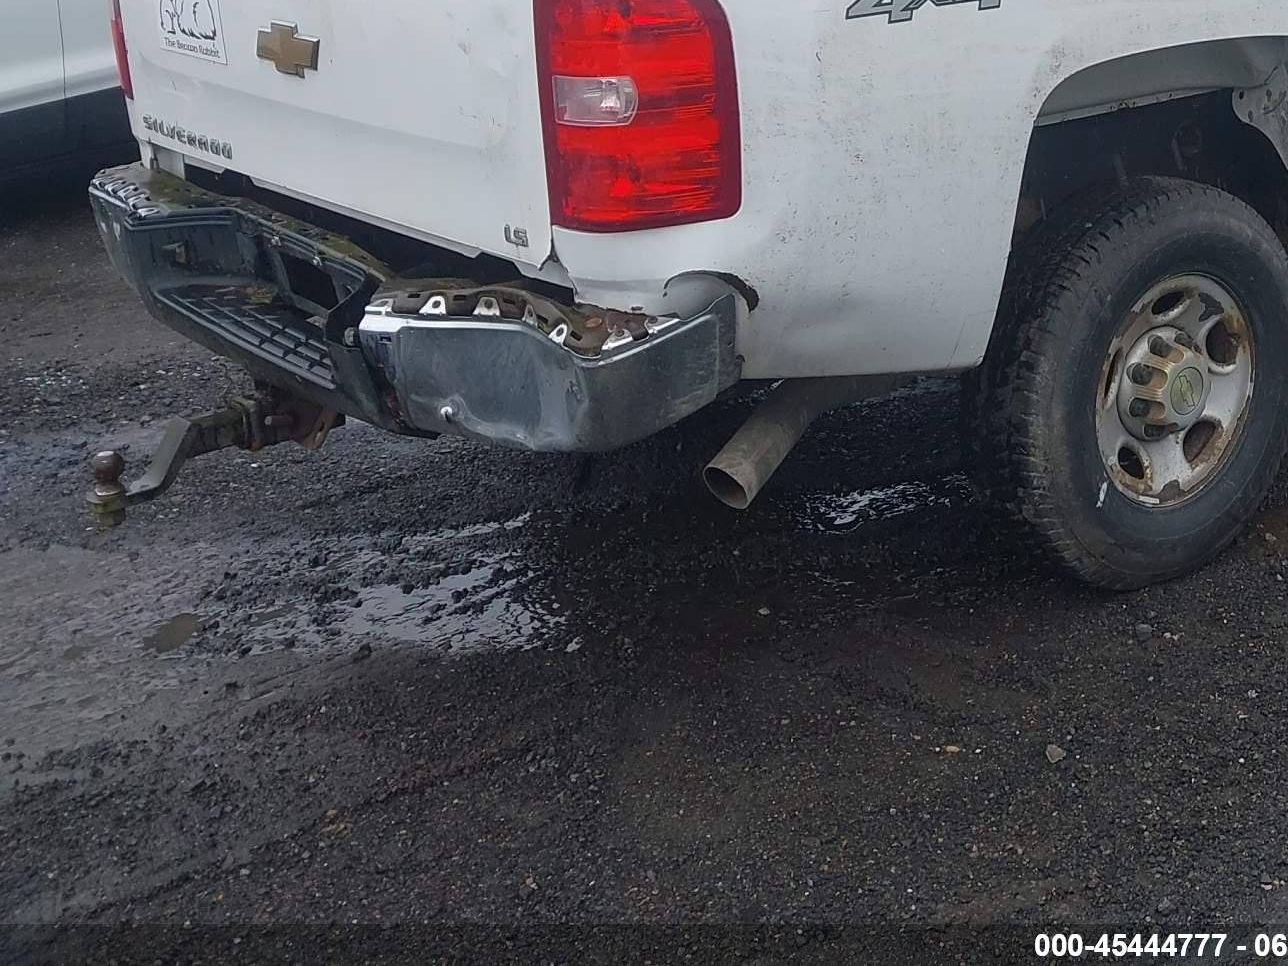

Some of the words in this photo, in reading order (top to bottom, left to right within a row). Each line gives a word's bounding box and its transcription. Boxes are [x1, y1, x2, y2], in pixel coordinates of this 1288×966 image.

[164, 37, 176, 48] The
[198, 44, 221, 58] Rabbit
[142, 114, 233, 160] SILVERADO
[503, 223, 529, 247] LS
